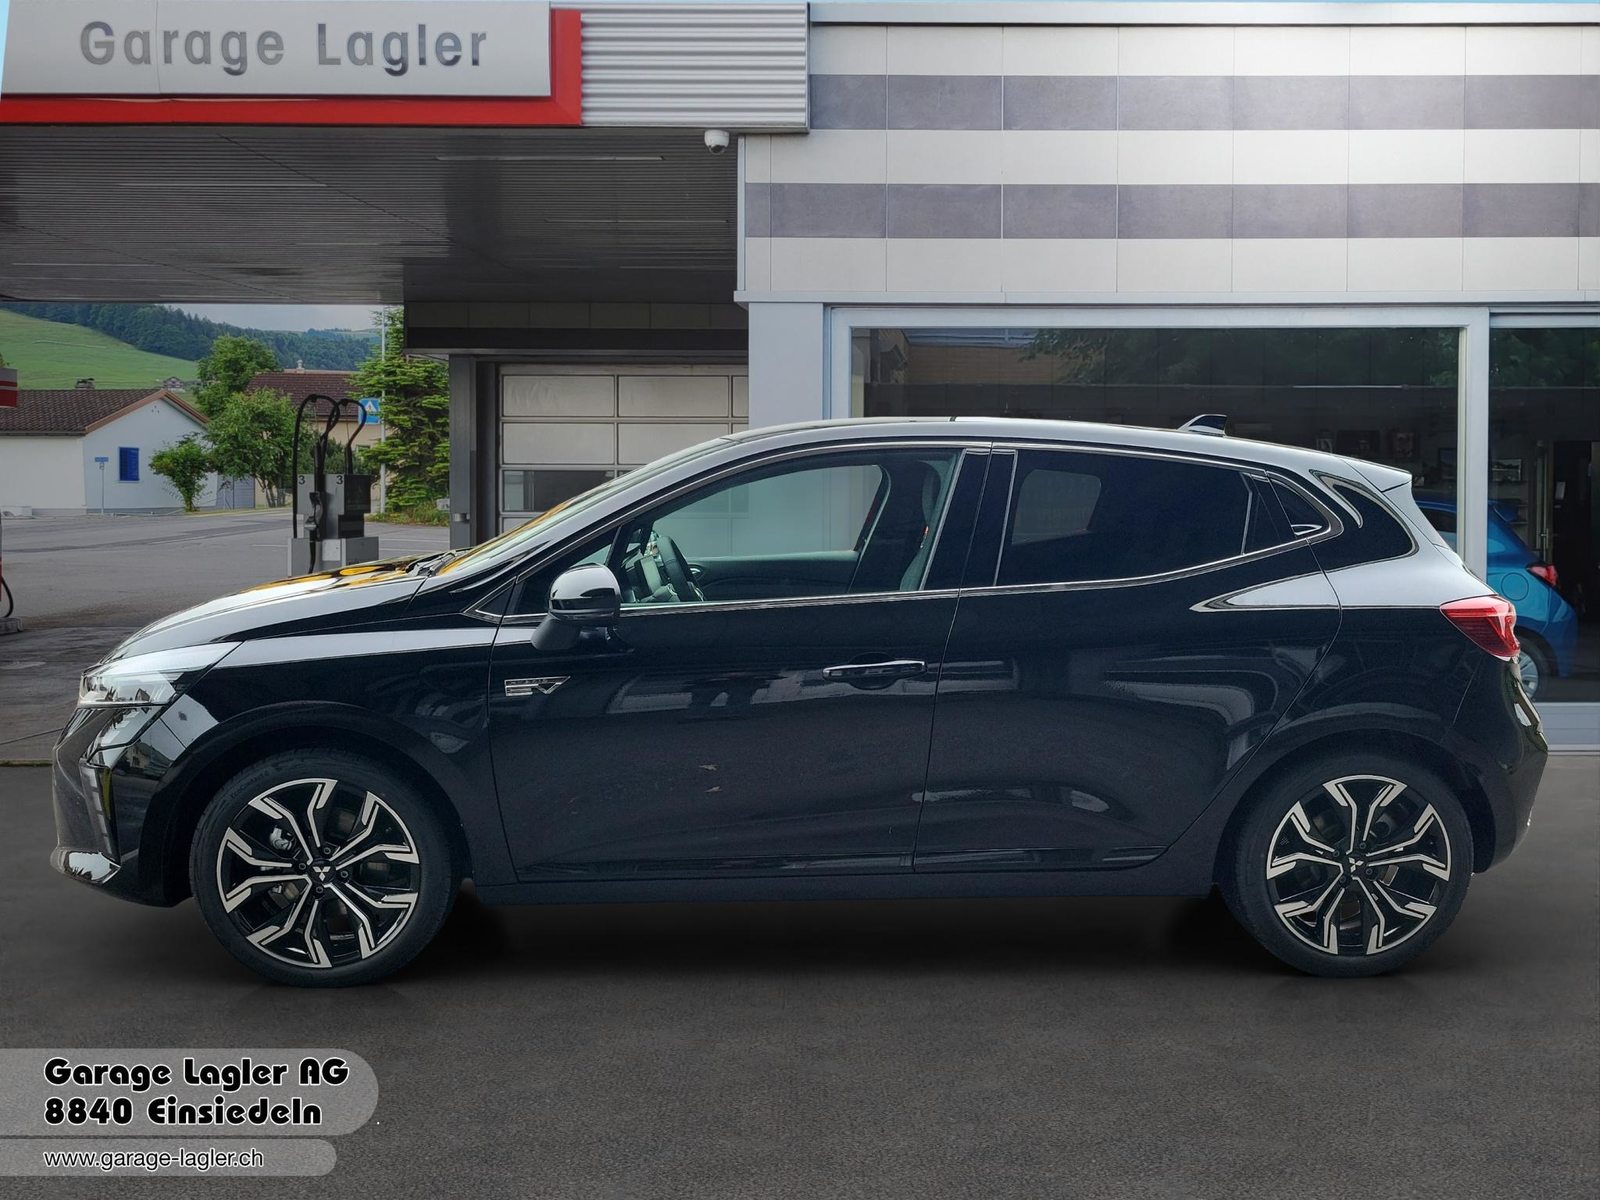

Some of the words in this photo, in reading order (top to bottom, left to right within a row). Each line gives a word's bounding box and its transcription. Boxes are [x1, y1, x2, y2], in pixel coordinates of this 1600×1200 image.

[80, 21, 284, 76] Garage
[317, 23, 487, 76] Lagler
[298, 475, 306, 485] 3
[336, 475, 344, 485] 3
